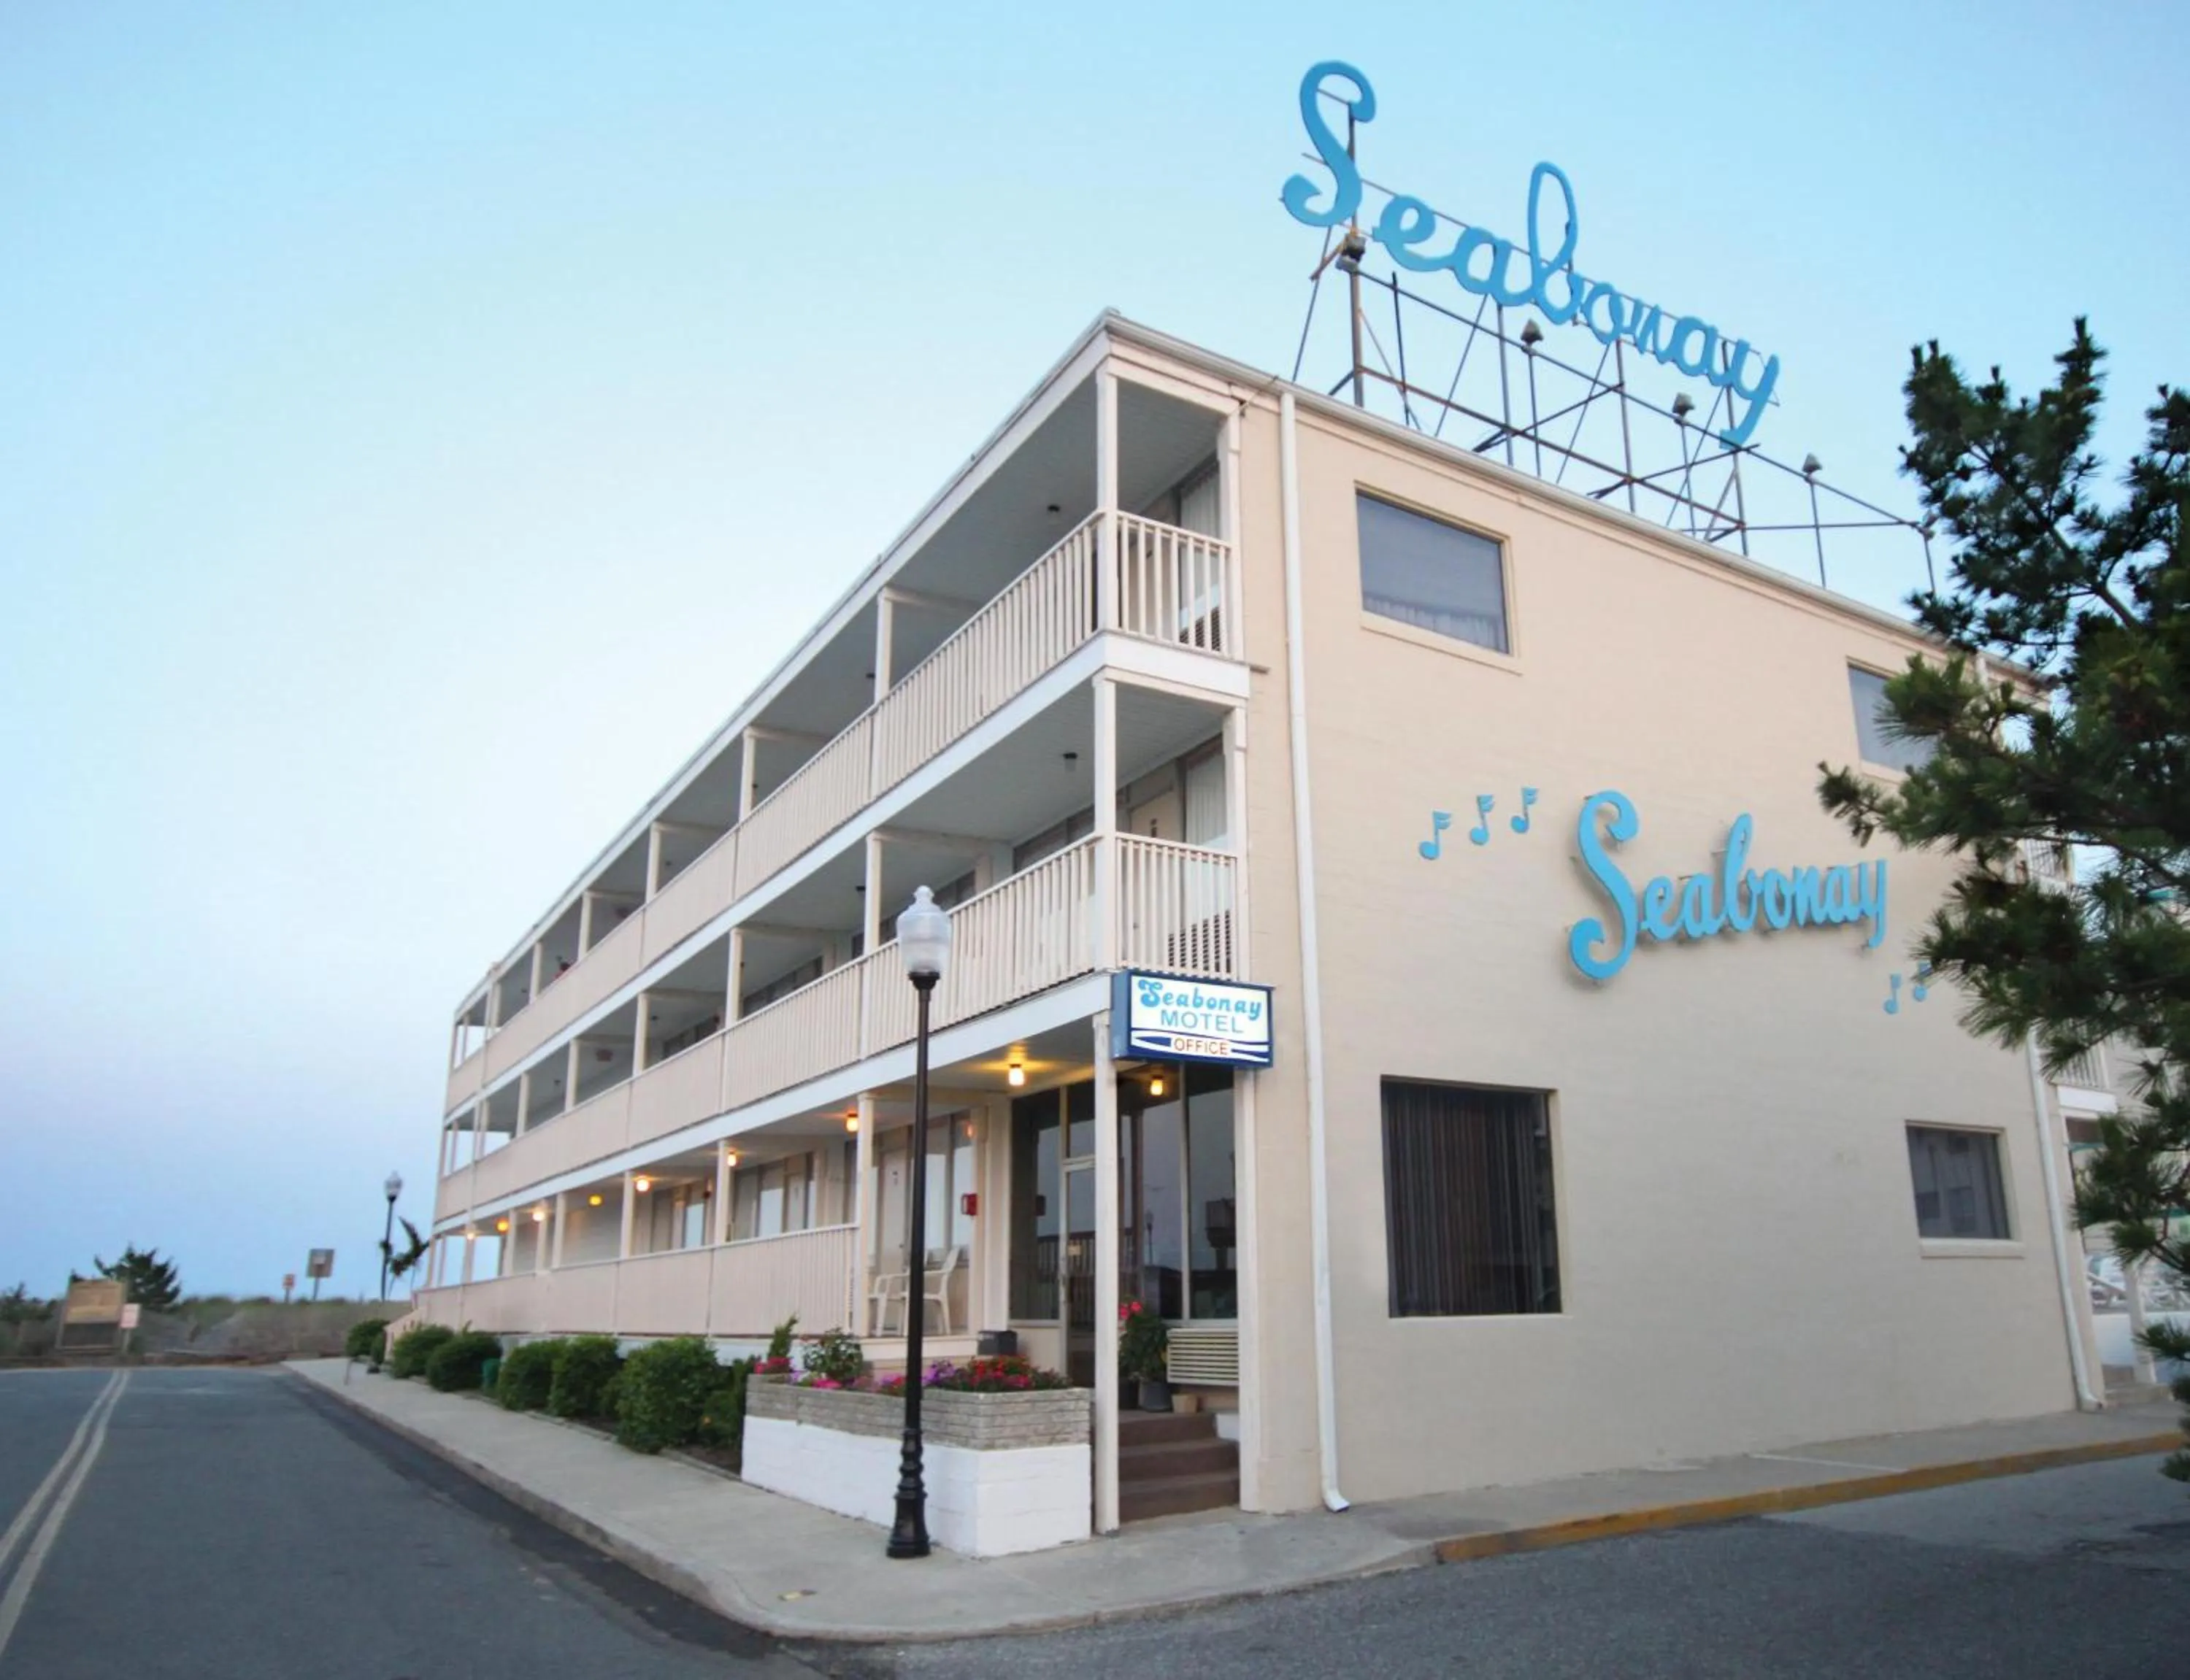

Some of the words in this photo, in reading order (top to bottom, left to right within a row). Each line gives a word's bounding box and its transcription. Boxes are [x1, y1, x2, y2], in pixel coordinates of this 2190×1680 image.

[1283, 61, 1779, 449] Seabonay
[1570, 790, 1886, 979] Seabonay
[1138, 979, 1261, 1020] Seabonay
[1161, 1009, 1243, 1033] MOTEL
[1174, 1038, 1229, 1055] OFFICE
